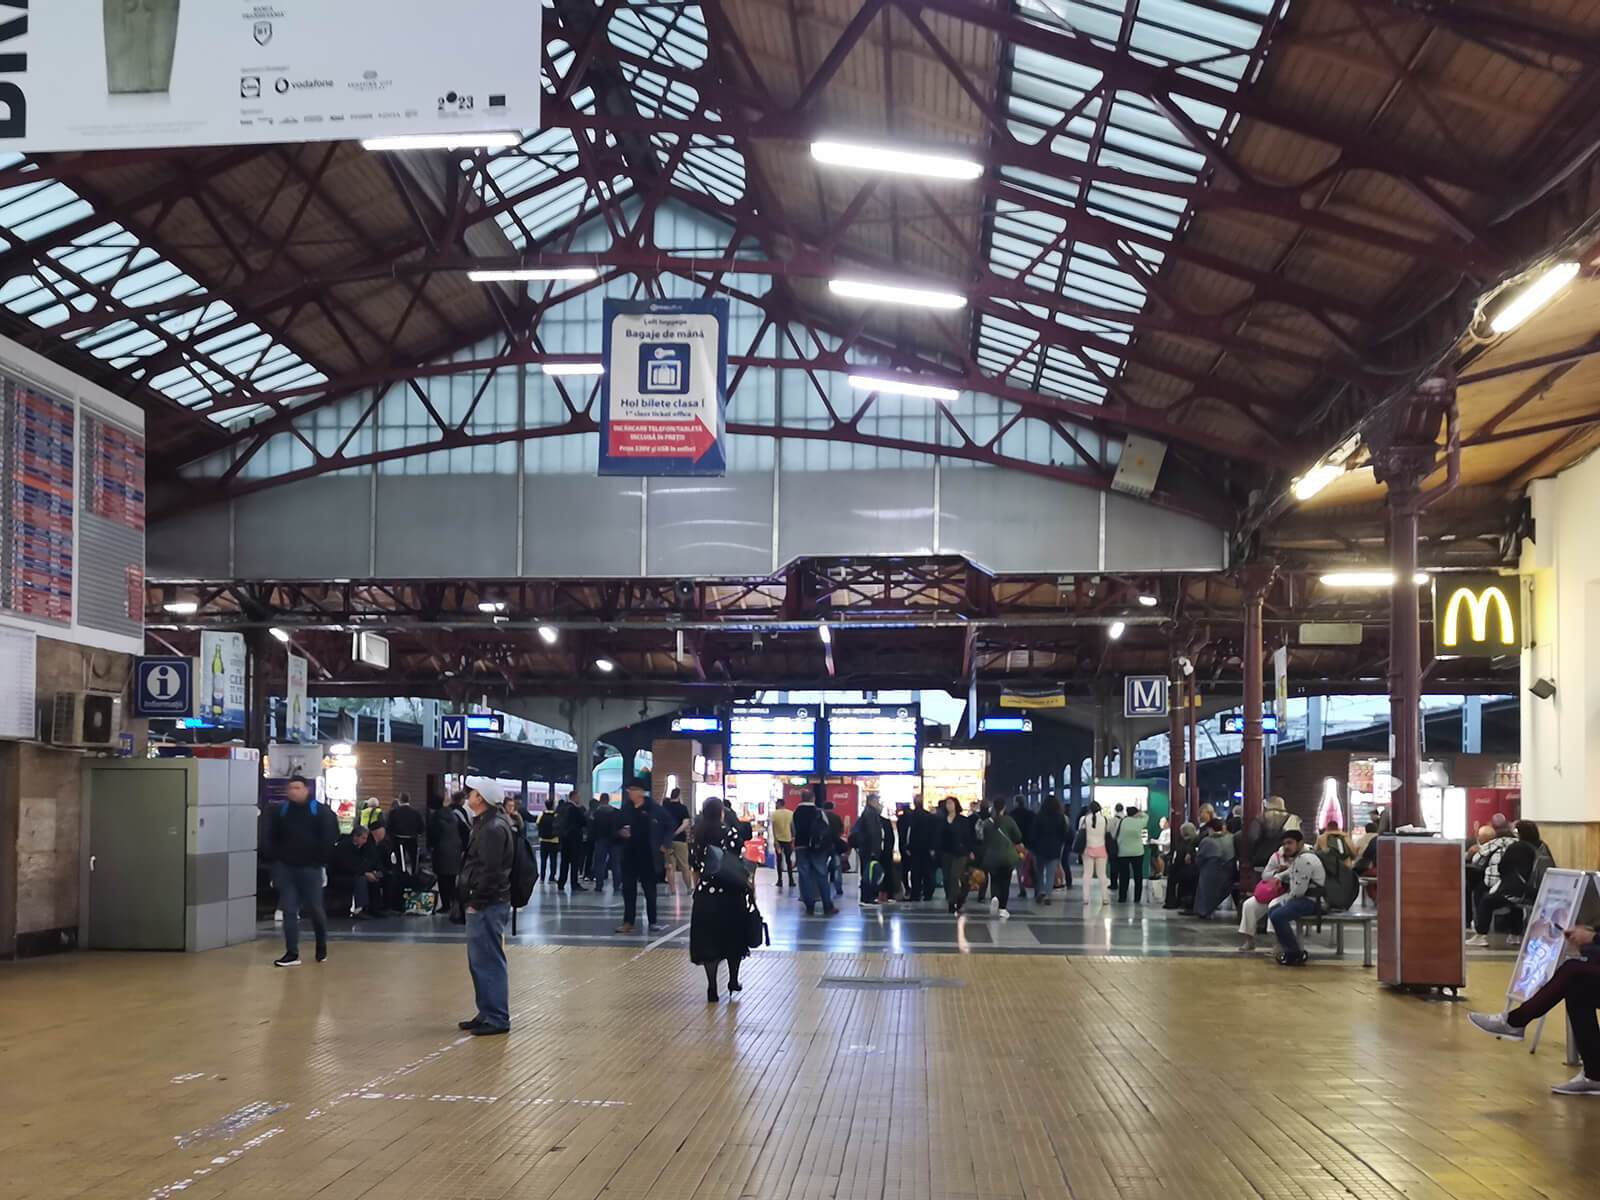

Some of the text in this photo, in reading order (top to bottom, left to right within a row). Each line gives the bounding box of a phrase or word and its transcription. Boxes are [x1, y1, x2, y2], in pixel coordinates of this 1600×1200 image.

[290, 79, 334, 89] vodafone
[625, 328, 660, 341] Bagaje
[662, 328, 675, 338] de
[621, 398, 639, 408] Hol
[641, 398, 671, 408] bilete
[673, 398, 699, 408] clasa
[1134, 680, 1161, 708] M
[444, 720, 461, 739] M
